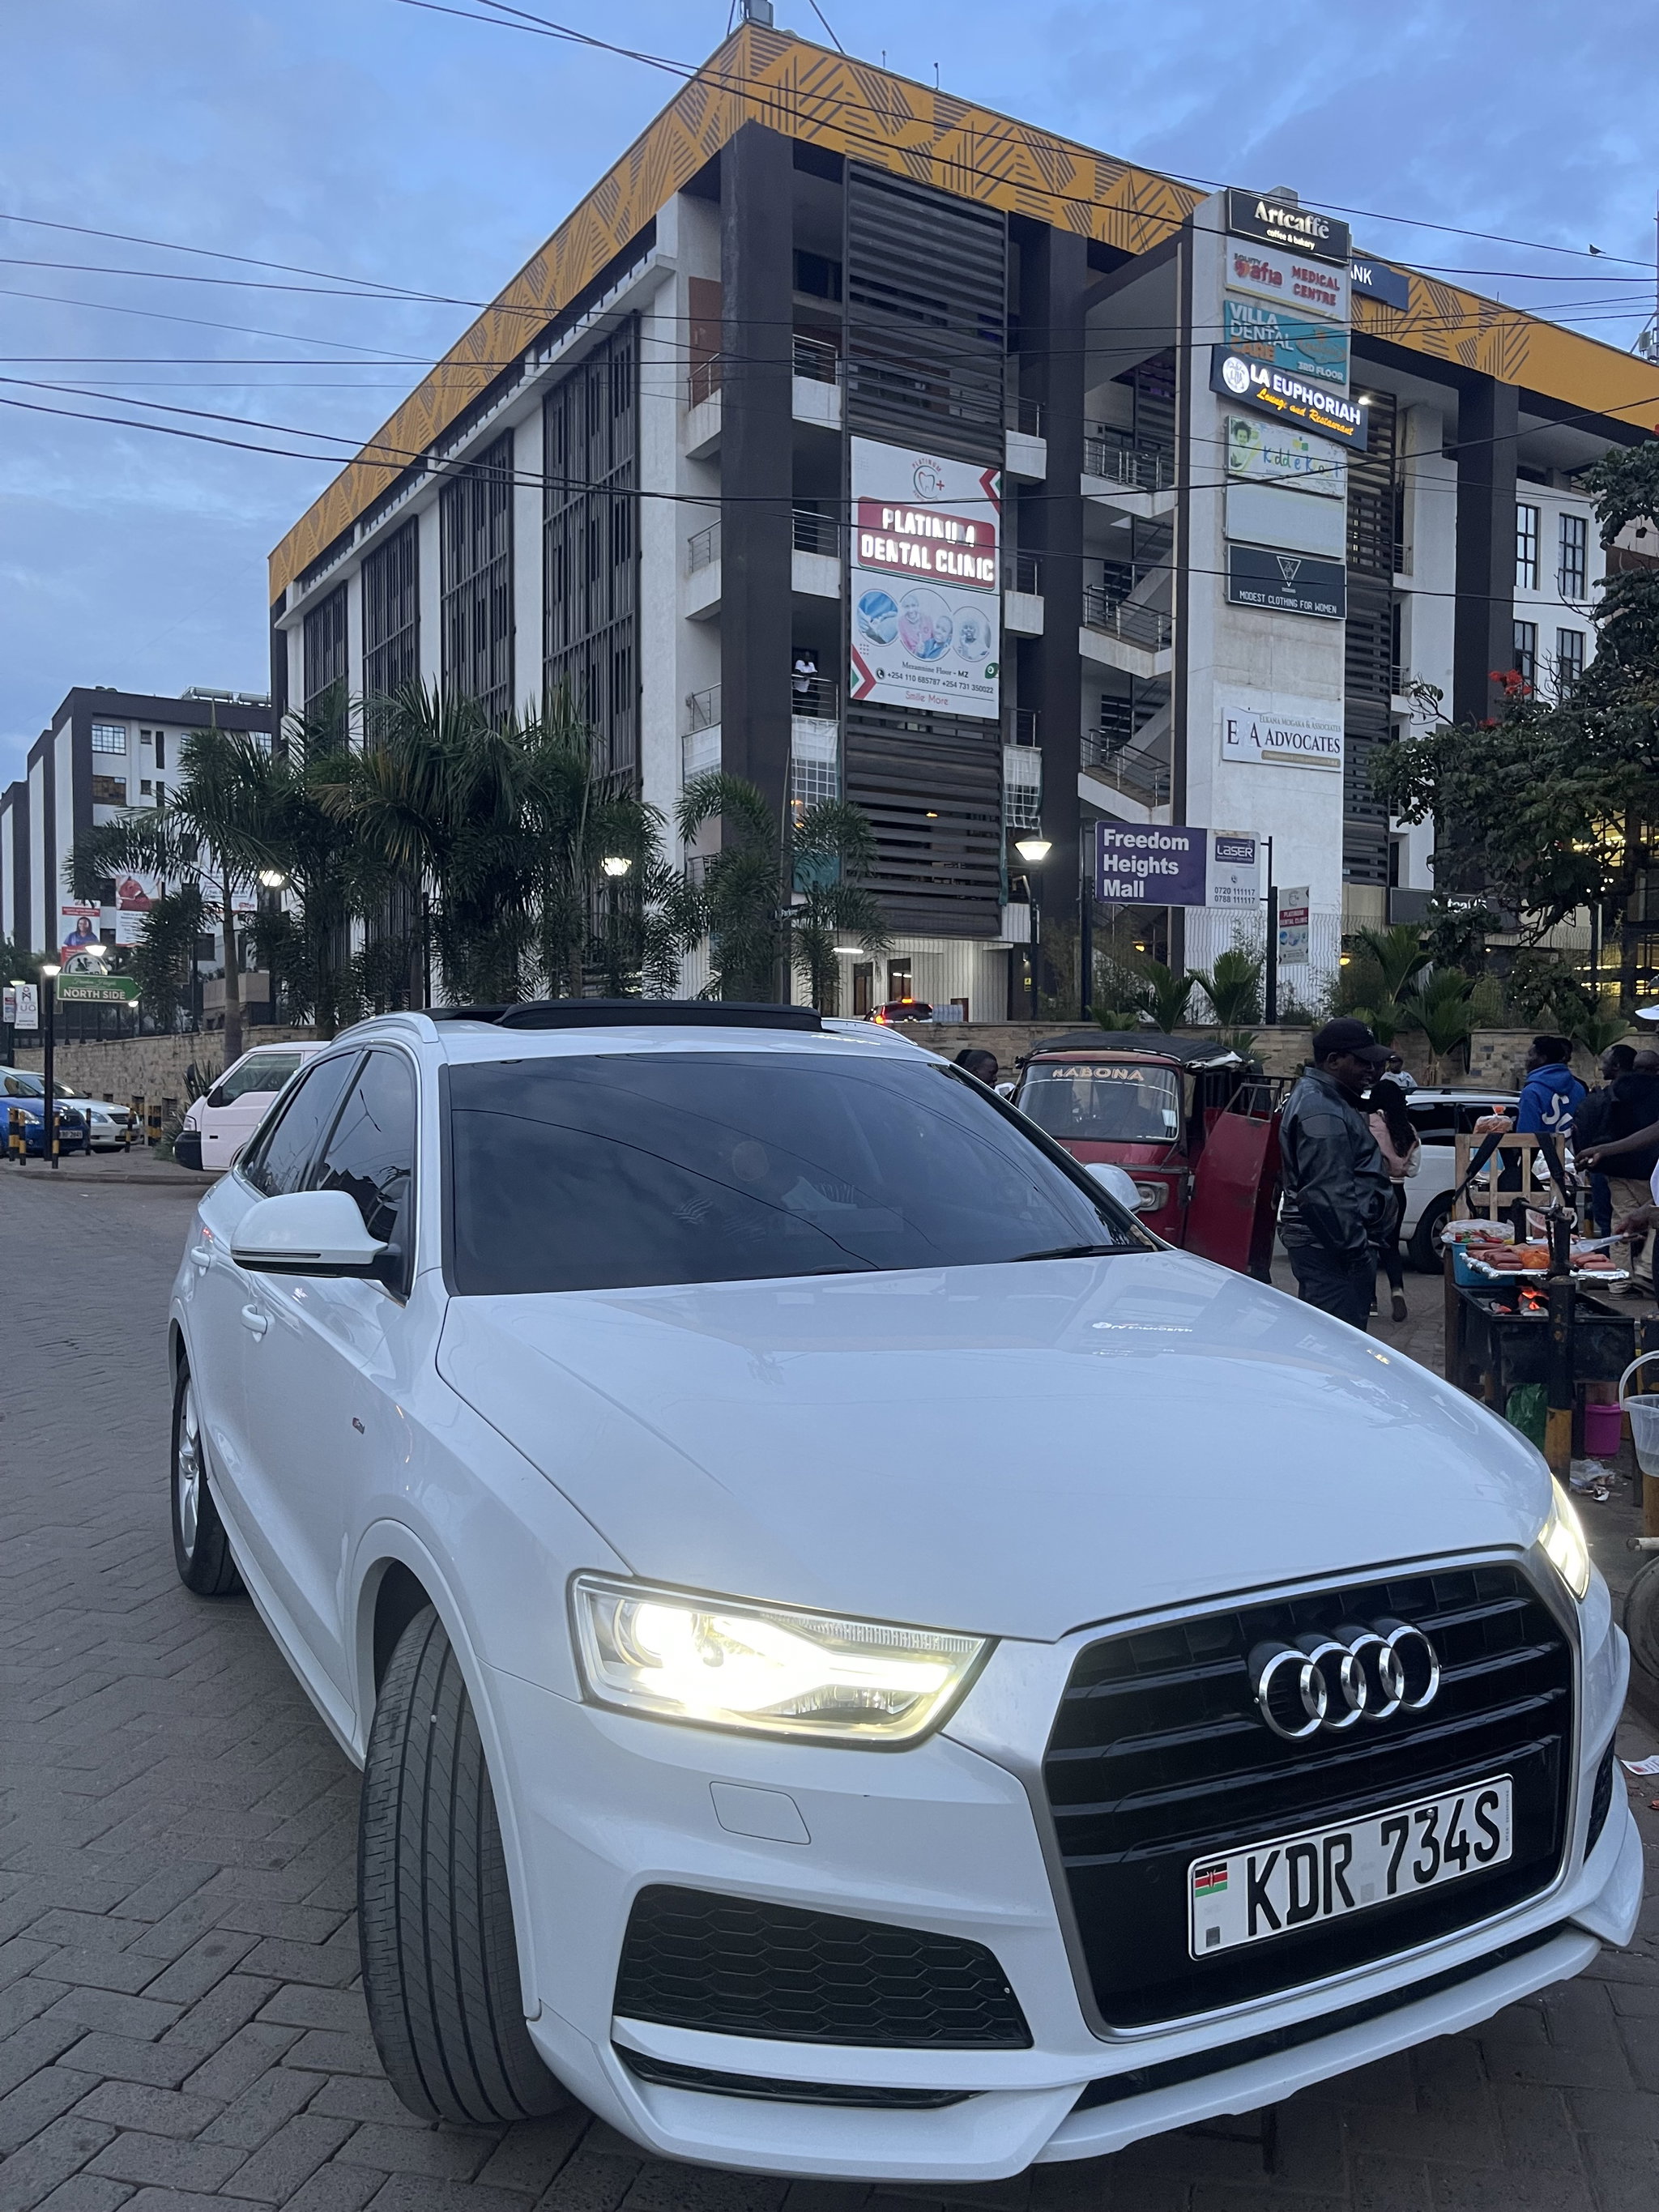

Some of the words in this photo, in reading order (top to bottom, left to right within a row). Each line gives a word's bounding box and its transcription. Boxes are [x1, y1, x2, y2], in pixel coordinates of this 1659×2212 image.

[1266, 228, 1287, 241] coffee
[1287, 234, 1293, 243] &
[1293, 236, 1316, 250] bakery
[1291, 266, 1341, 292] MEDICAL
[1293, 283, 1337, 306] CENTRE
[1230, 302, 1279, 330] VILLA
[1230, 319, 1294, 351] DENTAL
[1231, 336, 1275, 363] CARE
[1298, 361, 1315, 373] 3RD
[1316, 366, 1344, 381] FLOOR
[1250, 364, 1271, 388] LA
[1273, 374, 1361, 425] EUPHORIAH
[1256, 388, 1287, 411] Lounge
[1290, 405, 1306, 416] and
[1308, 408, 1354, 436] Restaurant
[861, 534, 932, 570] DENTAL
[935, 549, 994, 582] CLINIC
[1239, 590, 1265, 603] MODEST
[1268, 595, 1298, 608] CLOTHING
[1299, 600, 1312, 610] FOR
[1314, 602, 1337, 614] WOMEN
[887, 671, 903, 680] +254
[905, 674, 916, 682] 110
[942, 680, 957, 688] +254
[972, 684, 994, 694] 350022
[936, 667, 952, 676] Floor
[905, 690, 925, 701] Smile
[928, 694, 949, 705] More
[1311, 722, 1341, 732] ASSOCIATES
[1265, 727, 1341, 754] ADVOCATES
[1103, 829, 1189, 850] Freedom
[1103, 854, 1179, 877] Heights
[1103, 879, 1145, 897] Mall
[1214, 895, 1231, 903] 0788
[1233, 896, 1255, 904] 111117
[1233, 888, 1255, 896] 111117
[63, 989, 100, 999] NORTH
[102, 991, 126, 999] SIDE
[1247, 1833, 1355, 1937] KDR
[1380, 1789, 1500, 1895] 734S
